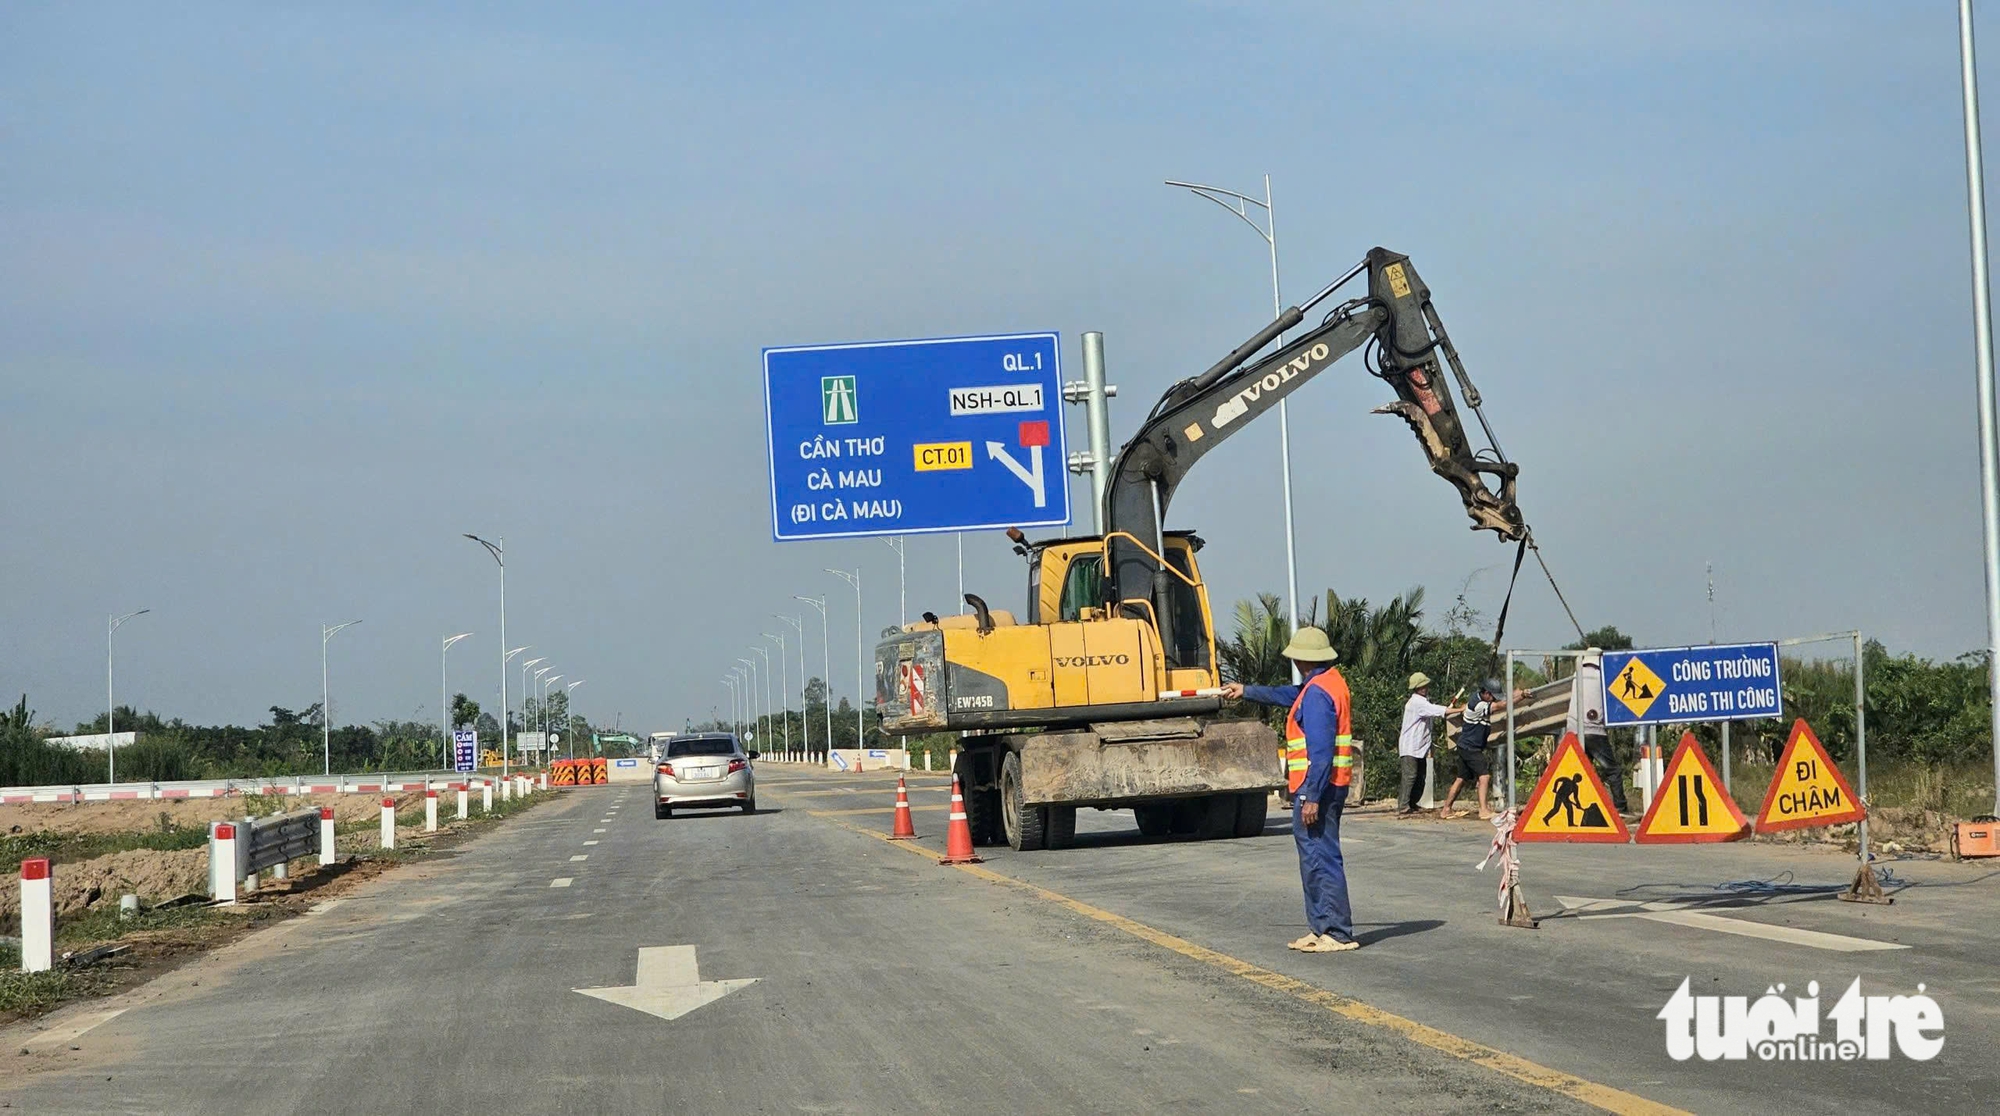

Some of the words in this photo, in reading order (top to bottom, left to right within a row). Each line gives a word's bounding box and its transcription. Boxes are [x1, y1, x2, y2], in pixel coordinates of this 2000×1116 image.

[1003, 353, 1042, 371] QL.1
[1239, 343, 1330, 402] VOLVO
[952, 389, 1042, 410] NSH-QL.1
[799, 435, 840, 459] CẦN
[844, 436, 885, 456] THƠ
[921, 449, 966, 466] CT.01
[808, 469, 834, 490] CÀ
[839, 470, 882, 488] MAU
[791, 505, 816, 524] (ĐI
[822, 500, 848, 521] CÀ
[853, 500, 902, 519] MAU)
[1053, 654, 1130, 668] VOLVO
[1672, 659, 1711, 682] CÔNG
[1715, 654, 1771, 679] TRƯỜNG
[957, 695, 994, 709] EW145B
[1668, 694, 1708, 714] ĐANG
[1711, 692, 1735, 710] THI
[1738, 686, 1775, 710] CÔNG
[1796, 760, 1817, 781] ĐI
[1779, 785, 1841, 815] CHẬM
